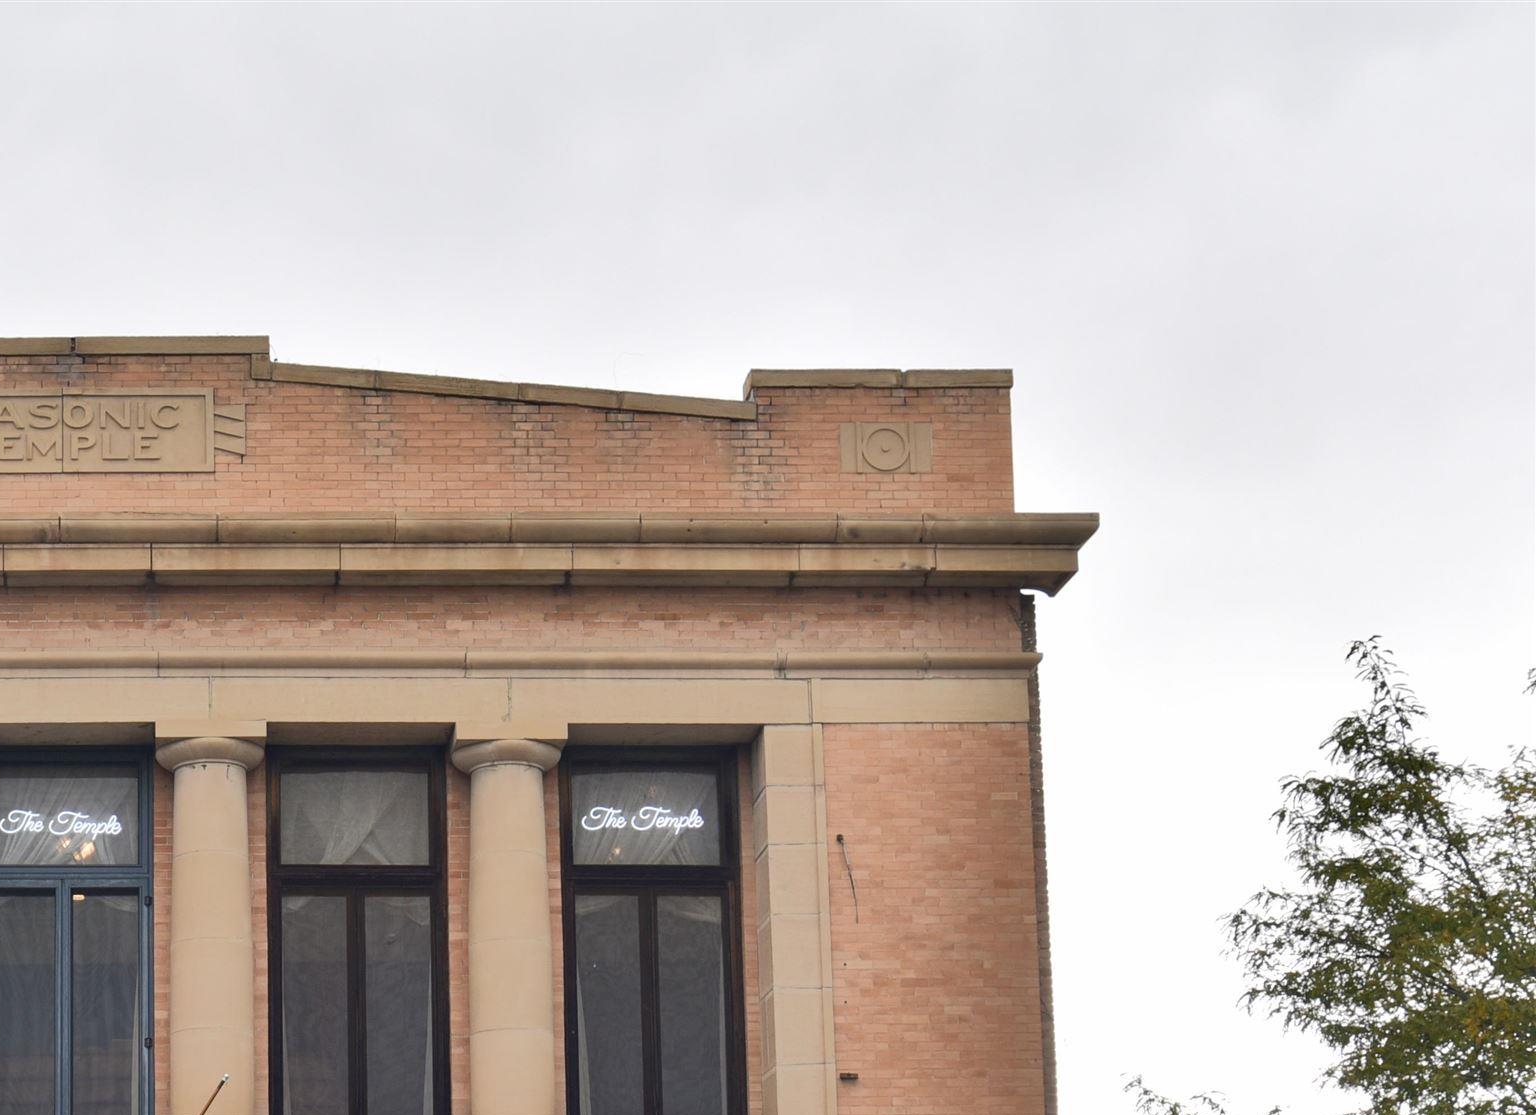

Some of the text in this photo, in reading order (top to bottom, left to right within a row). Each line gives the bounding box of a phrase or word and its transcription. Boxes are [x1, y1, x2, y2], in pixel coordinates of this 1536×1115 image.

[0, 809, 123, 840] The Temple
[581, 806, 705, 835] The Temple
